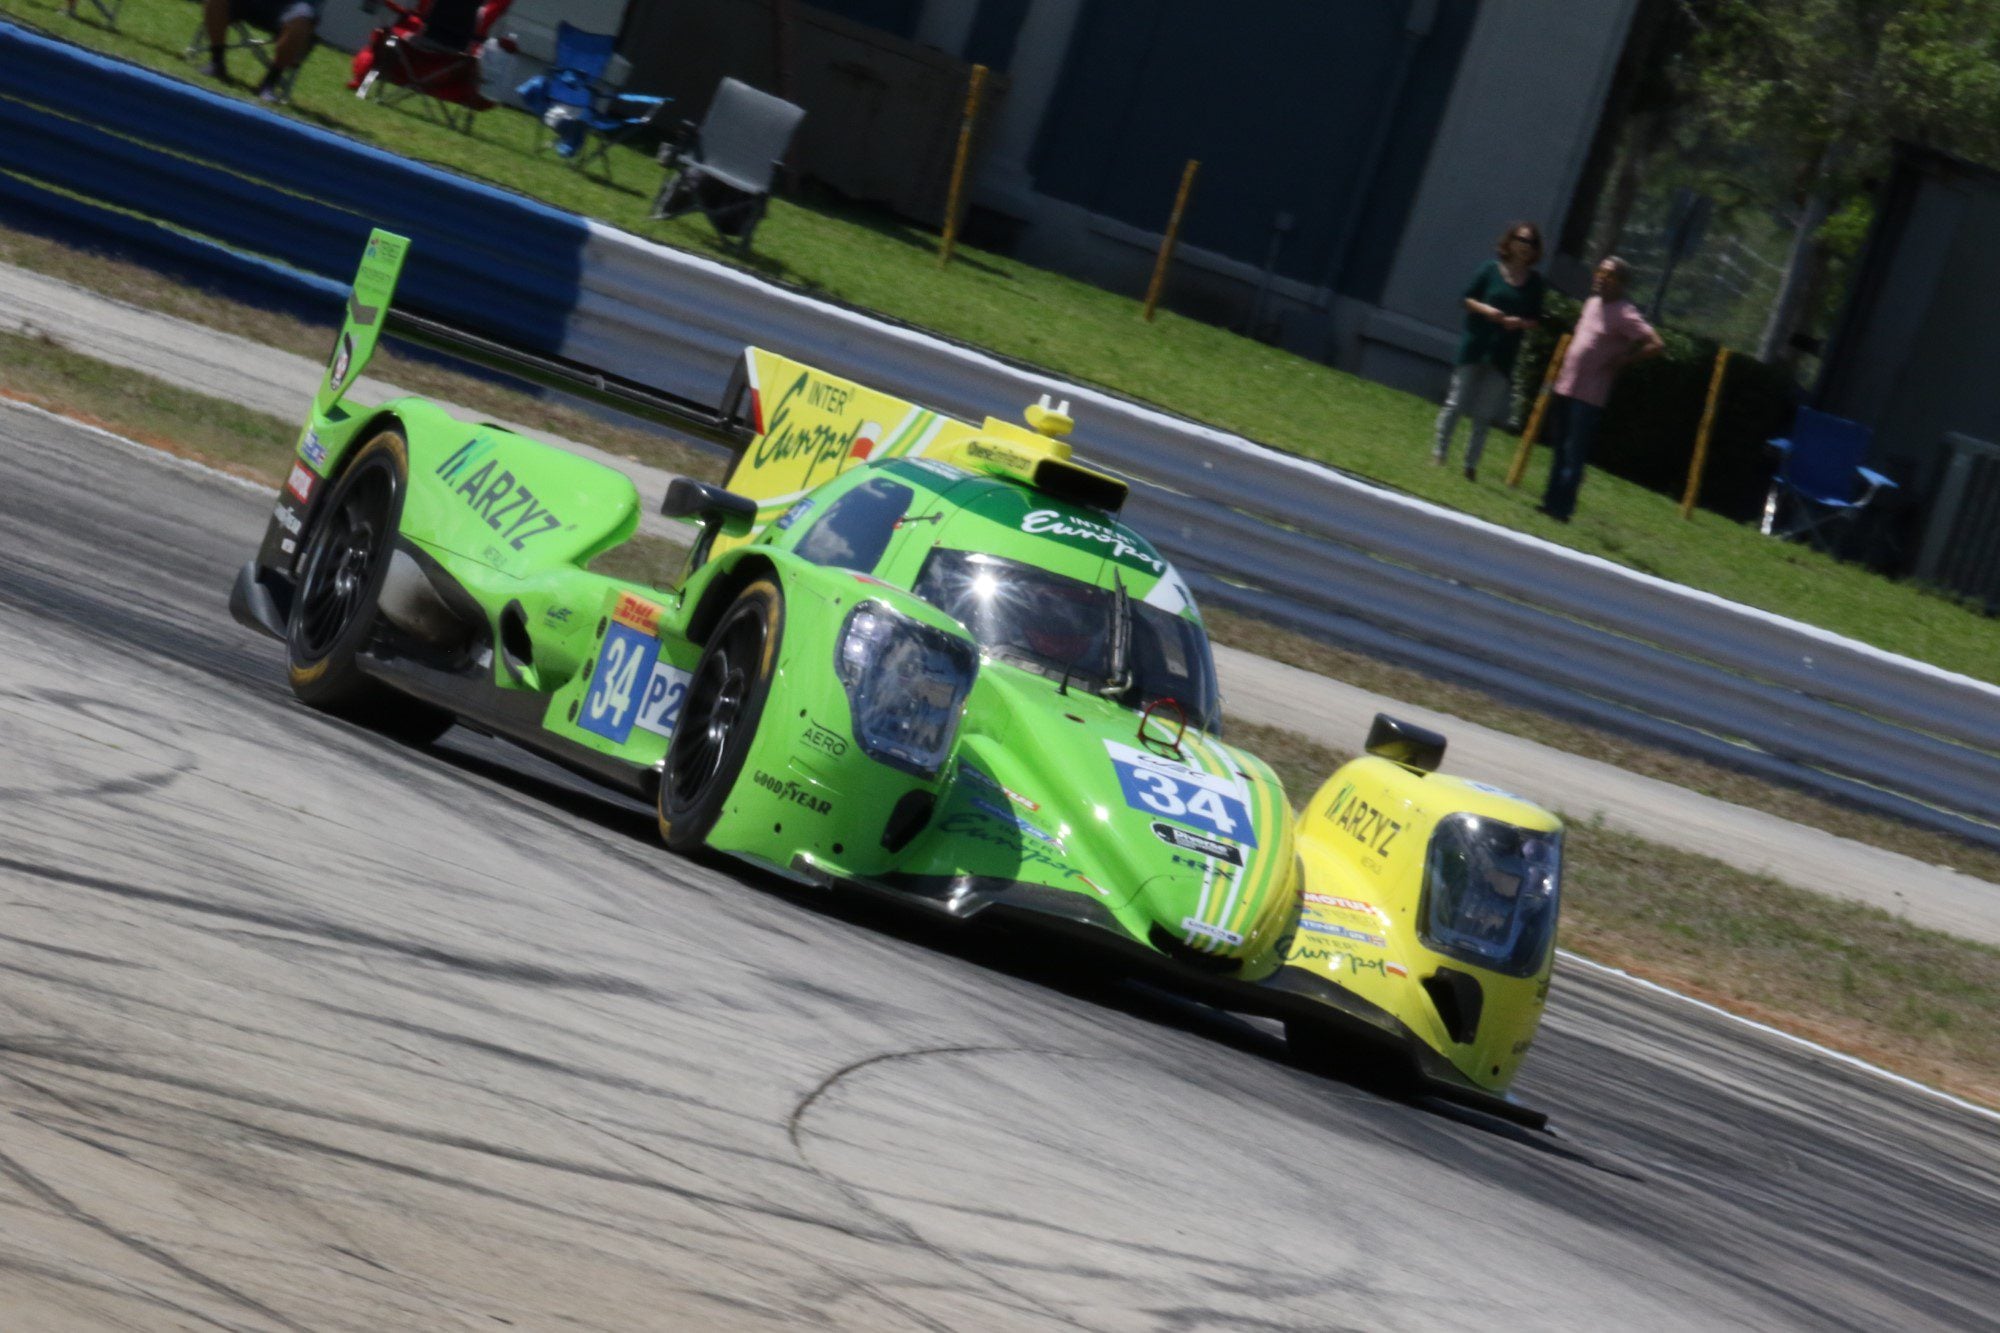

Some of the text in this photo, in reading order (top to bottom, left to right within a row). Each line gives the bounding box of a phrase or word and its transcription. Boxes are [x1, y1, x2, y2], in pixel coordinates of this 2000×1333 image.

[807, 381, 848, 415] INTER
[1069, 516, 1131, 544] INTER
[590, 636, 645, 727] 34
[641, 673, 688, 728] P2
[802, 728, 846, 756] AERO
[754, 769, 832, 816] GOODYEAR
[1133, 768, 1237, 834] 34
